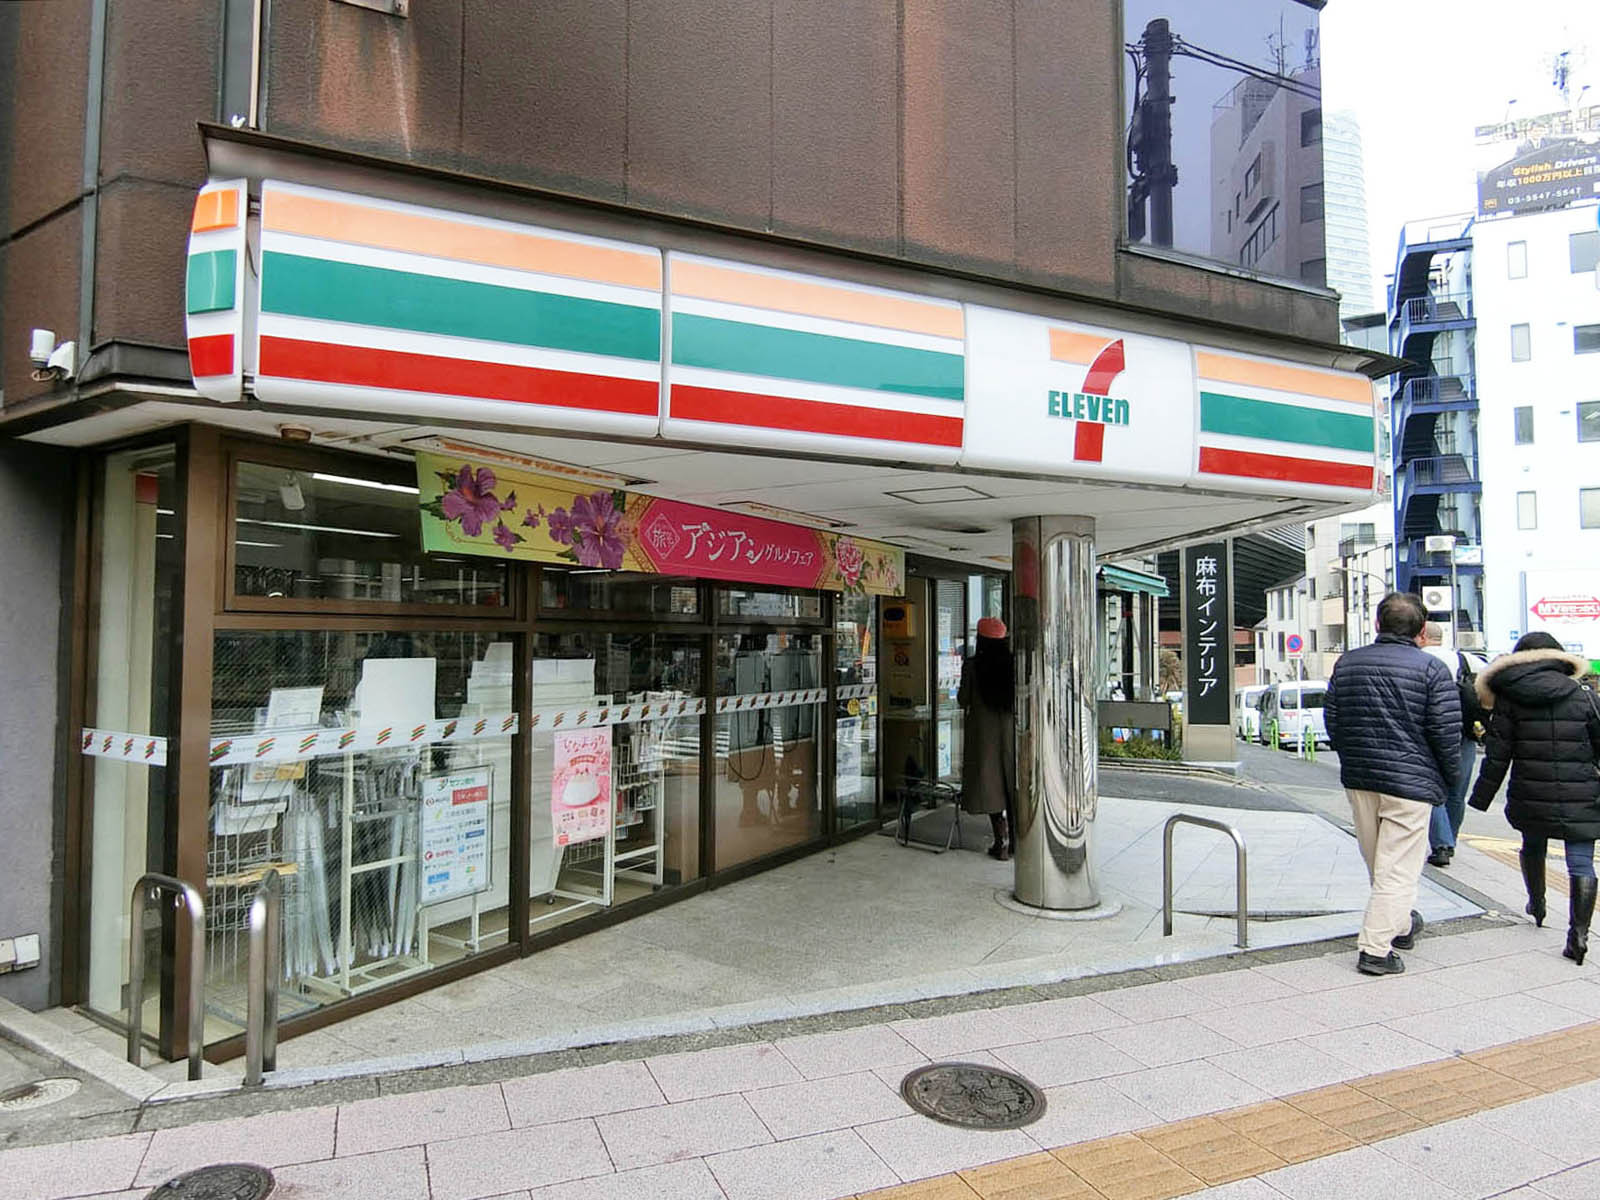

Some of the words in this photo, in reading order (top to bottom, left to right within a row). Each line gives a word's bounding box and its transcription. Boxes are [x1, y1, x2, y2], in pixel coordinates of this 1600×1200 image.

[1195, 556, 1217, 696] 麻布インテリア
